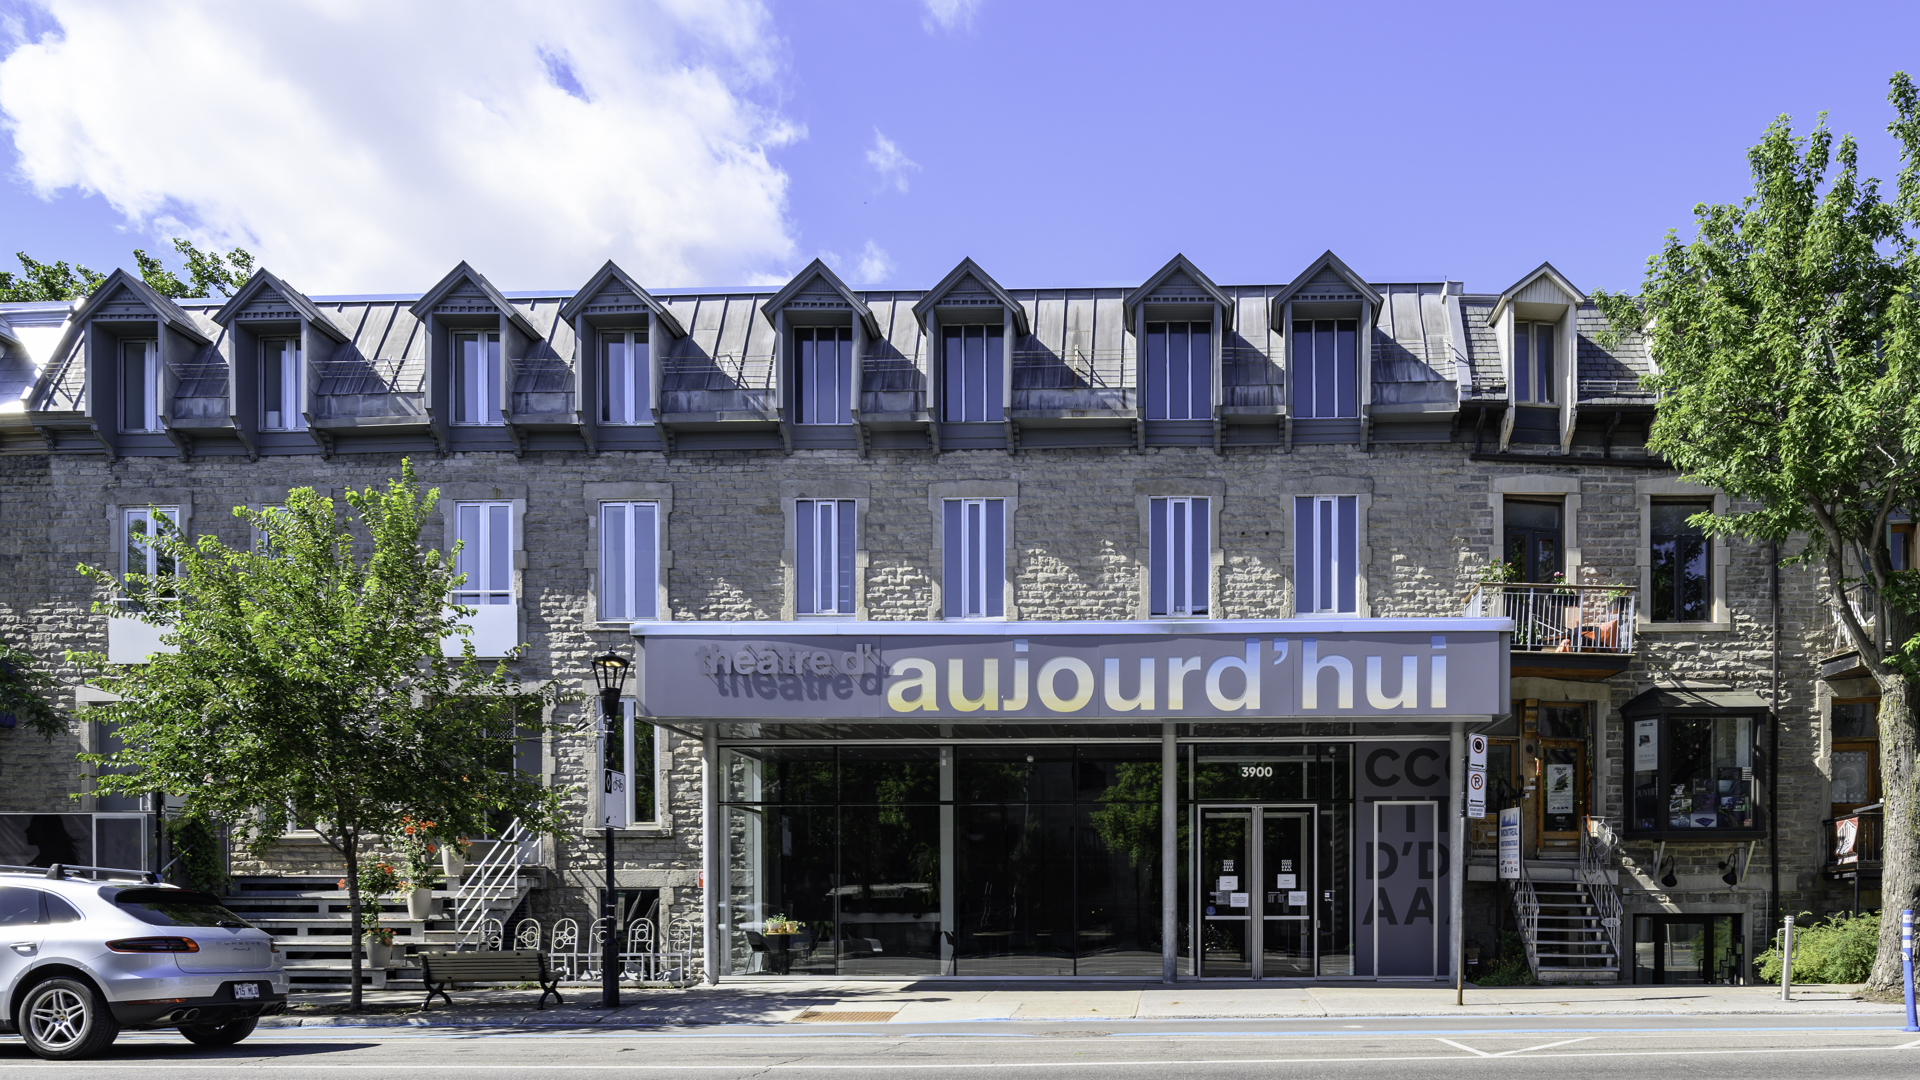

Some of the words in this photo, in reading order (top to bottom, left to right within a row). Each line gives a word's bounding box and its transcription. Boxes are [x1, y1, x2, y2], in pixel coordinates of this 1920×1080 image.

[695, 643, 832, 676] théâtre
[887, 636, 1447, 713] aujourd'hui
[1241, 766, 1273, 778] 3900
[1365, 748, 1450, 787] CC
